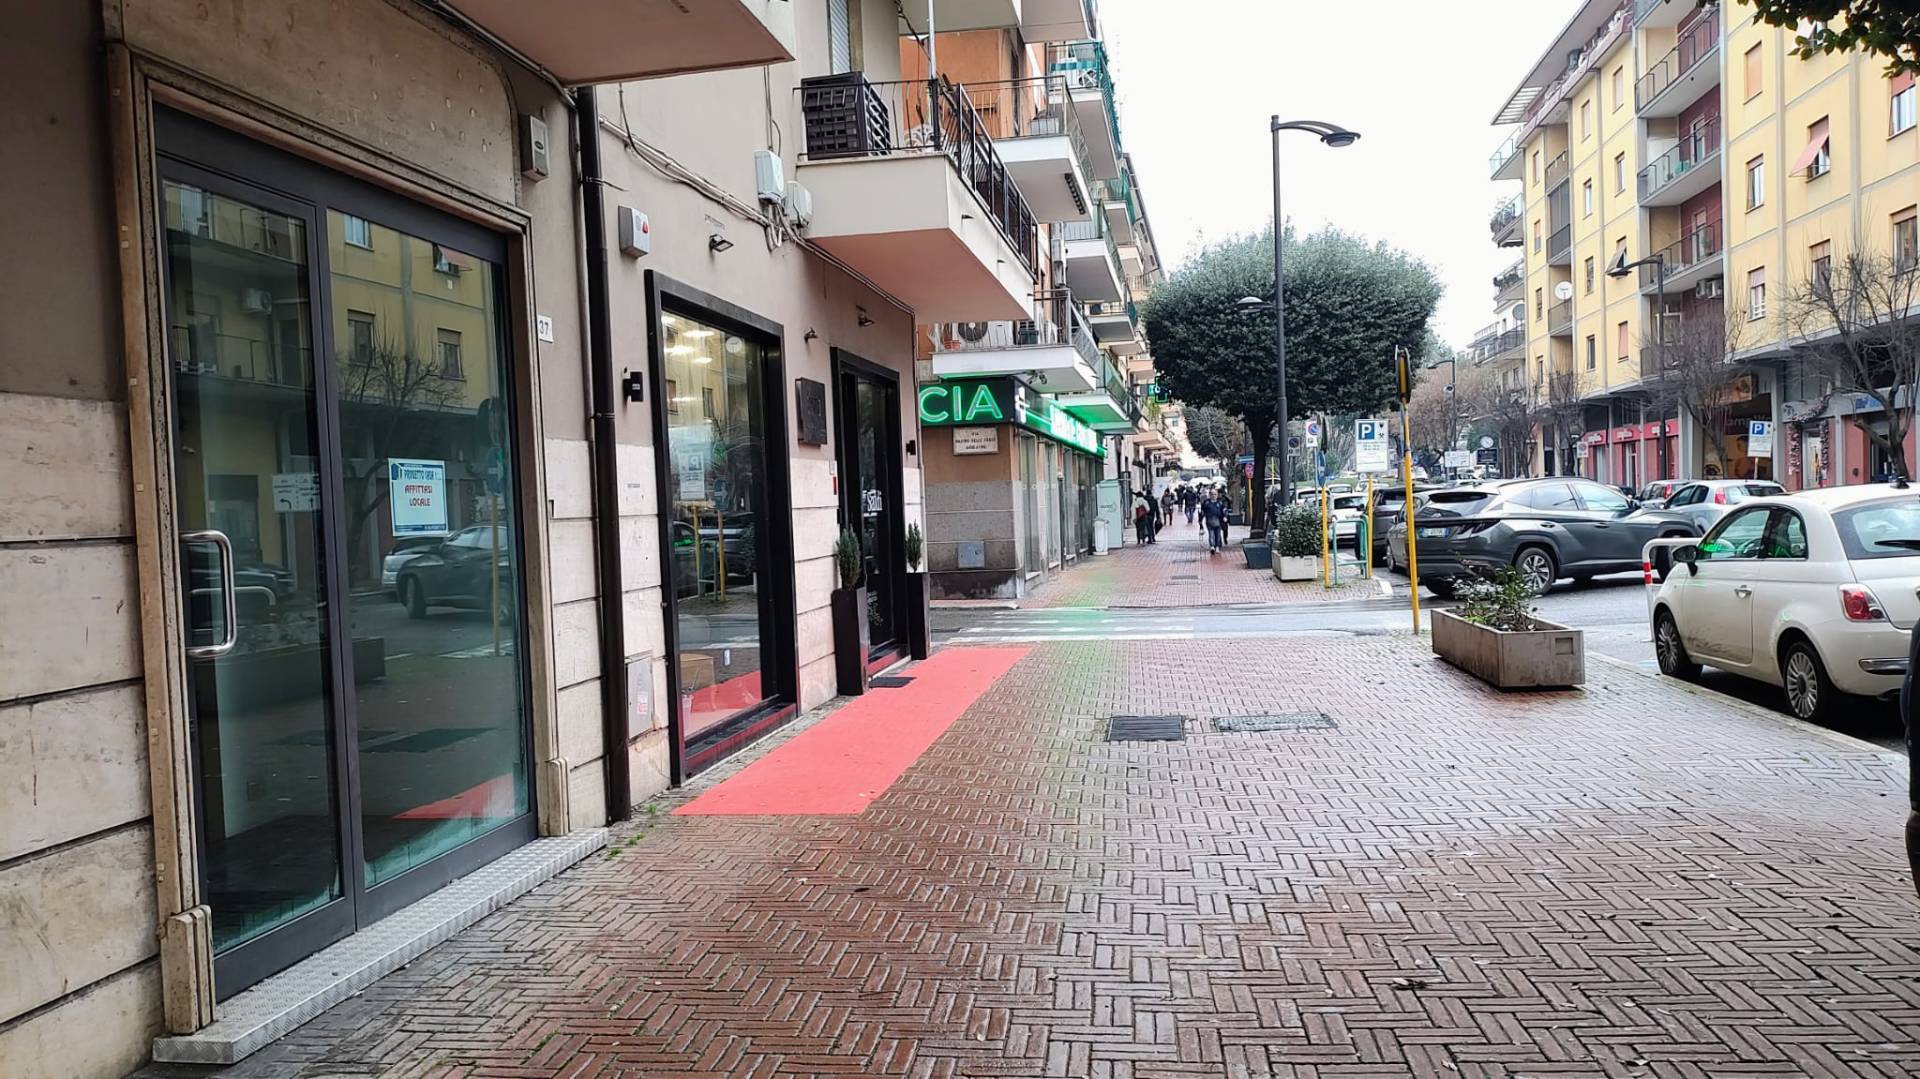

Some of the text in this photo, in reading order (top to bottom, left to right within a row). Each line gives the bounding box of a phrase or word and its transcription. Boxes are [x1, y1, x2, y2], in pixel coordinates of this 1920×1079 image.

[539, 319, 549, 336] 37
[919, 384, 1003, 423] CIA
[1361, 424, 1372, 439] P
[409, 497, 431, 507] LOCALE
